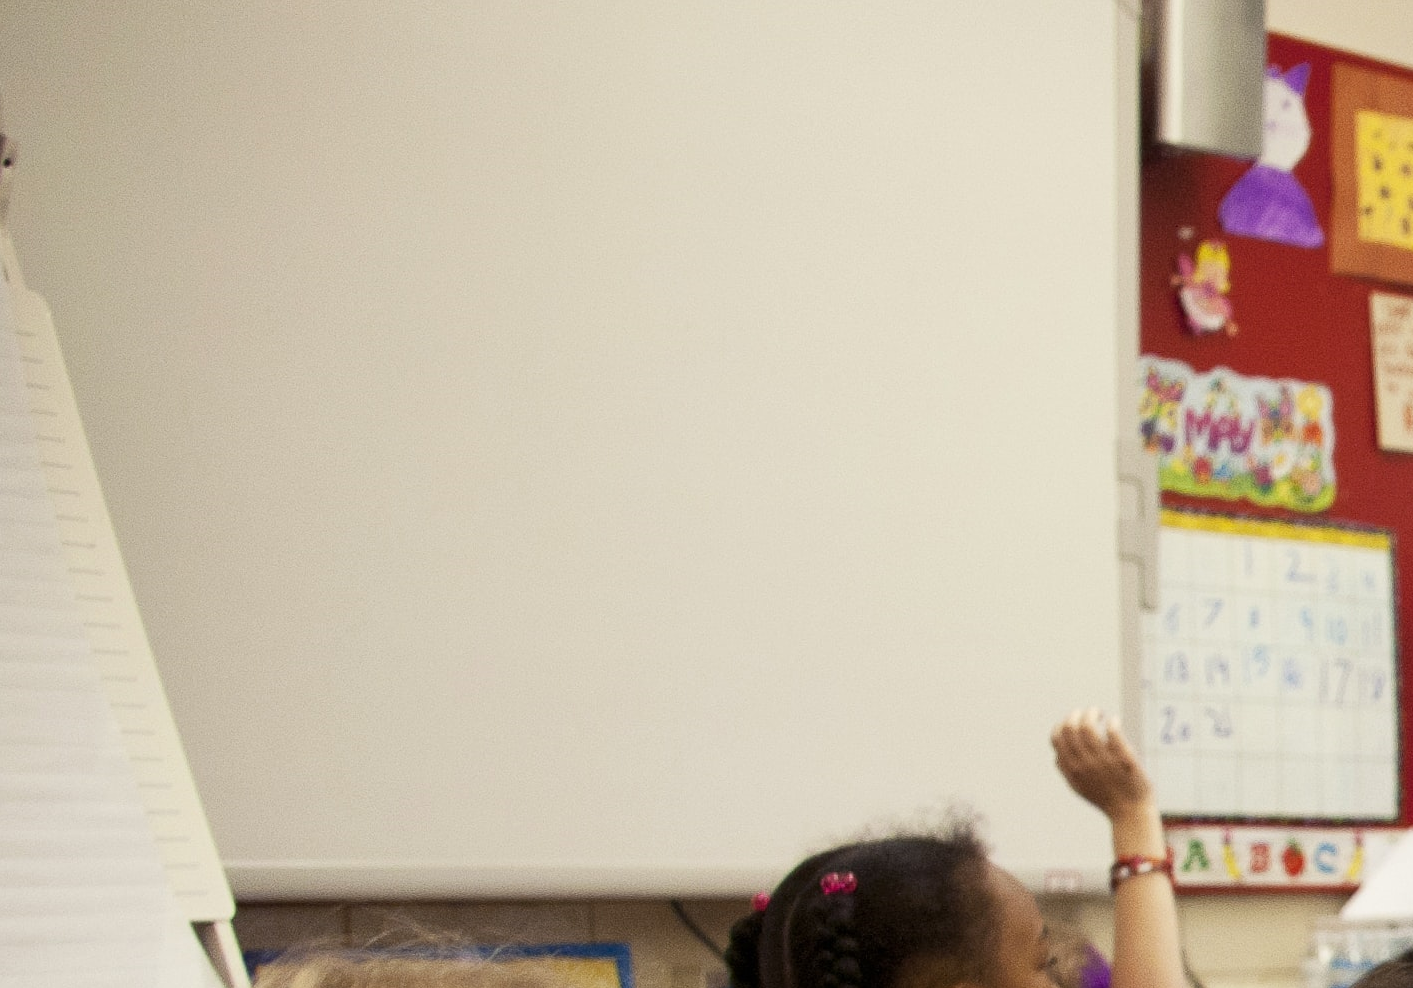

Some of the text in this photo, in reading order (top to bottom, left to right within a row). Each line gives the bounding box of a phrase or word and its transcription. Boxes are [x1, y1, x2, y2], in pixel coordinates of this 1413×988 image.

[1285, 548, 1317, 583] 2
[1203, 598, 1225, 628] 7
[1319, 658, 1352, 705] 17
[1181, 838, 1338, 874] A B C
